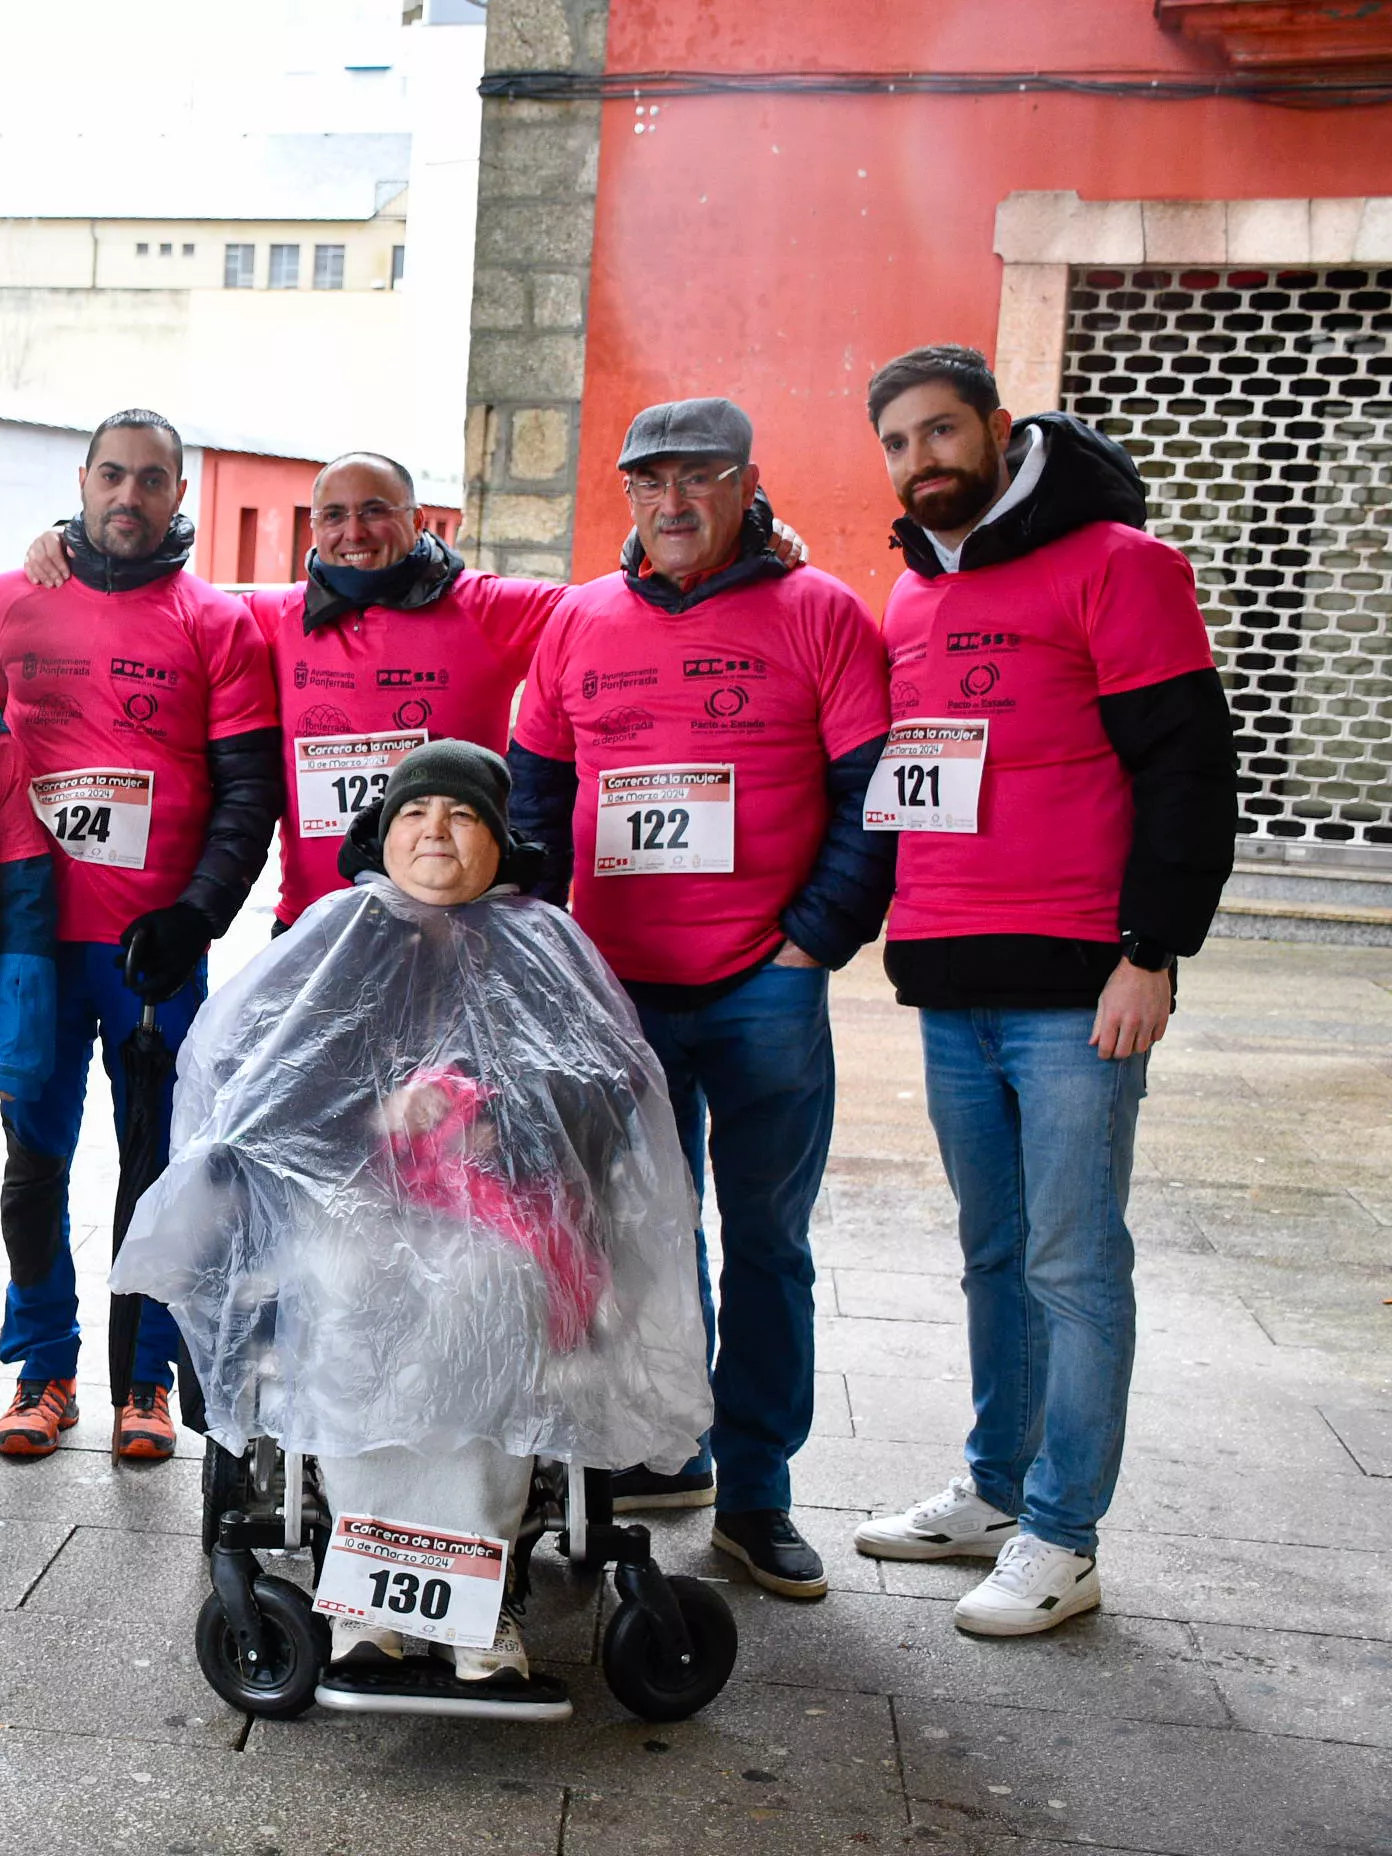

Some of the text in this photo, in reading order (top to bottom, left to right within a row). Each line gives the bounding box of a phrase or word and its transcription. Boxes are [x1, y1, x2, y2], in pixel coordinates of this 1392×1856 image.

[39, 666, 90, 677] Ponferrada
[310, 677, 356, 689] Ponferrada
[601, 677, 657, 691] Ponferrada
[913, 729, 924, 738] de
[926, 729, 937, 738] la
[939, 729, 977, 742] mujer
[308, 740, 418, 756] Carrera de la mujer
[919, 745, 938, 753] 2024
[329, 760, 361, 768] Marzo
[35, 776, 143, 792] Carrera de la mujer
[608, 773, 722, 788] Carrera de la mujer
[893, 764, 940, 807] 121
[53, 791, 86, 802] Marzo
[88, 789, 110, 797] 2024
[615, 794, 624, 802] de
[626, 793, 659, 801] Marzo
[661, 789, 684, 799] 2024
[53, 805, 112, 843] 124
[627, 808, 690, 850] 122
[350, 1522, 494, 1558] Carrera de la mujer
[344, 1538, 449, 1567] 10 de Marzo 2024
[369, 1569, 452, 1620] 130
